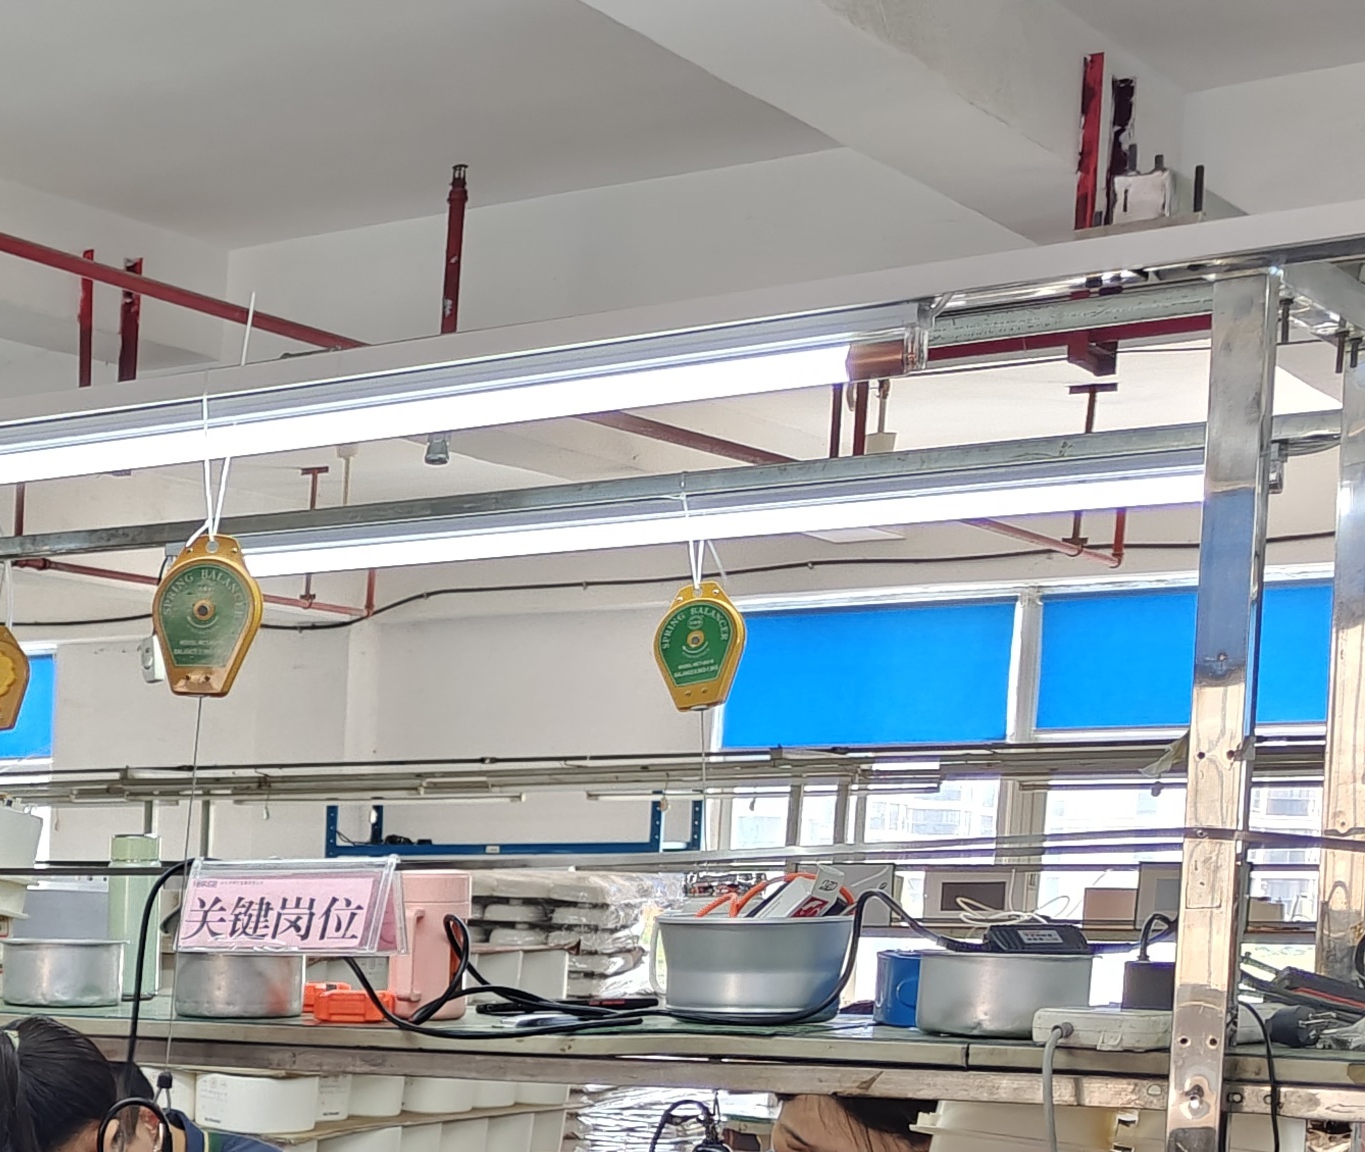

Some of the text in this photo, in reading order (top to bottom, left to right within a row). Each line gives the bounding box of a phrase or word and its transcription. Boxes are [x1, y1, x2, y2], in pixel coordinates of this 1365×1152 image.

[163, 572, 194, 615] SPRING
[661, 607, 729, 649] SPRING BALANCER
[181, 896, 364, 941] 关键岗位
